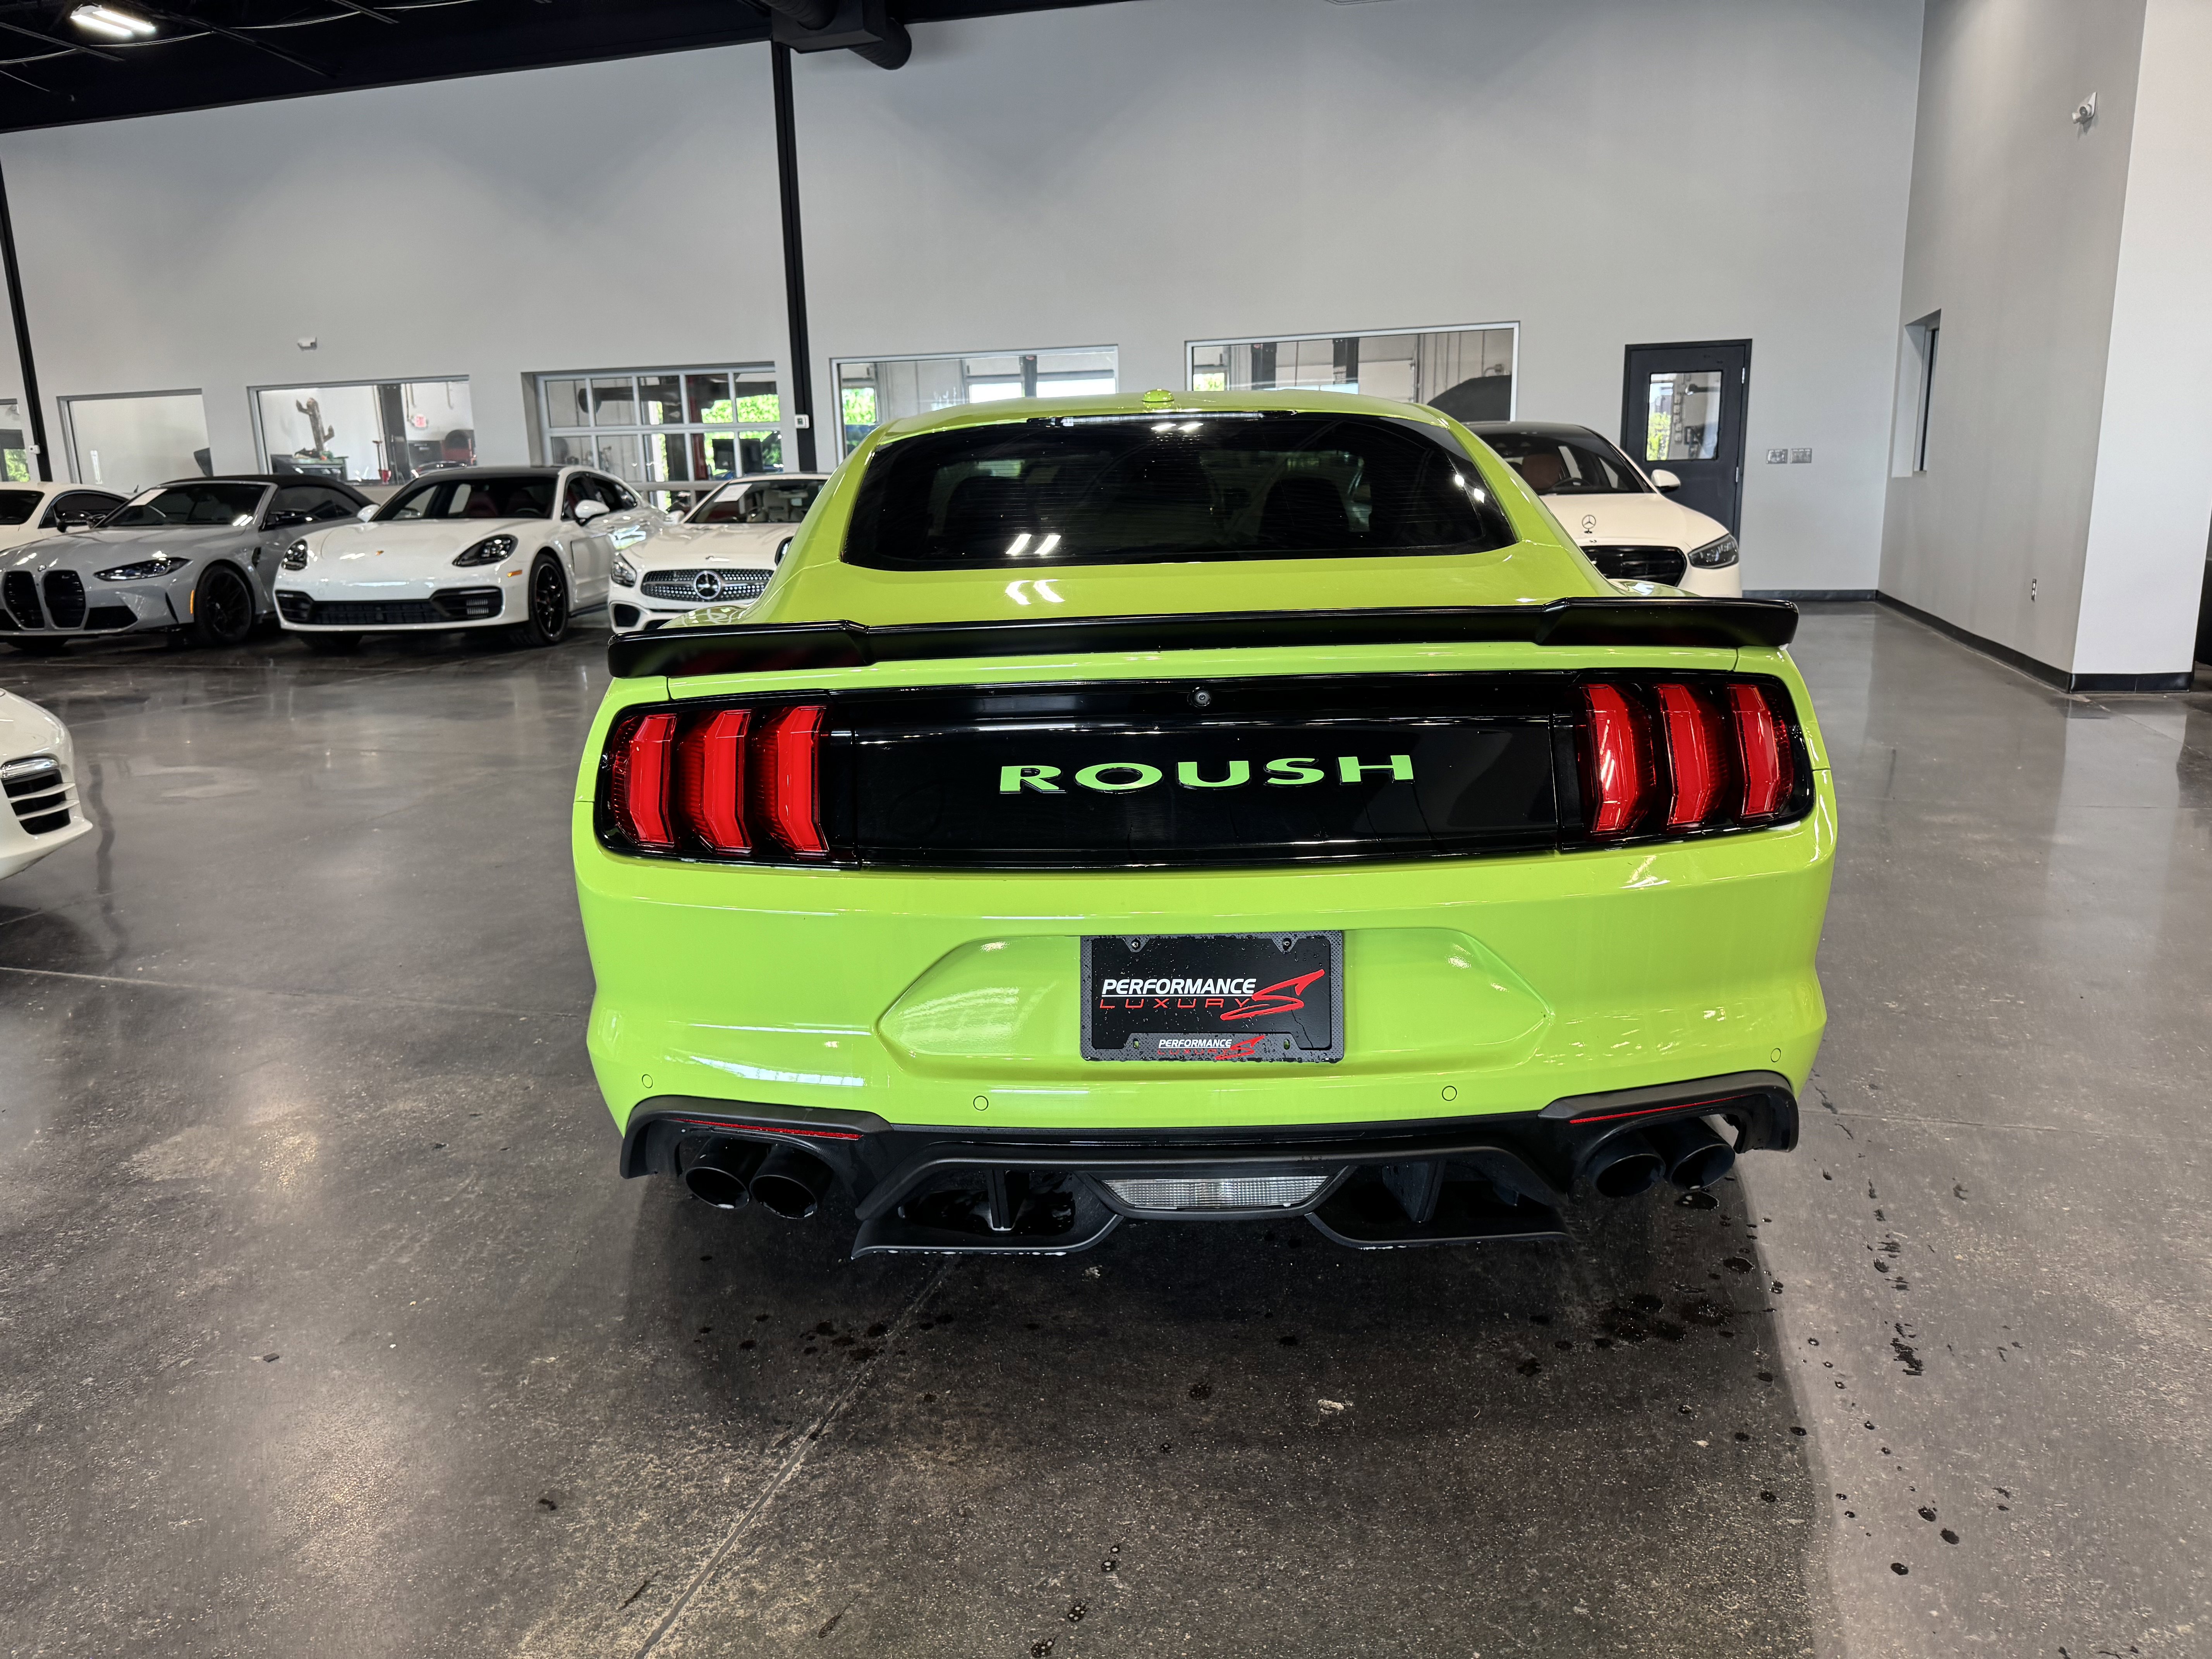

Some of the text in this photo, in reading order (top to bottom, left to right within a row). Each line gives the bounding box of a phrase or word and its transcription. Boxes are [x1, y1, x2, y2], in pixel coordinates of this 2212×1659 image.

[999, 755, 1414, 792] ROUSH
[1101, 978, 1257, 994] PERFORMANCE
[1099, 998, 1250, 1009] LUXURY
[1158, 1039, 1232, 1048] PERFORMANCE
